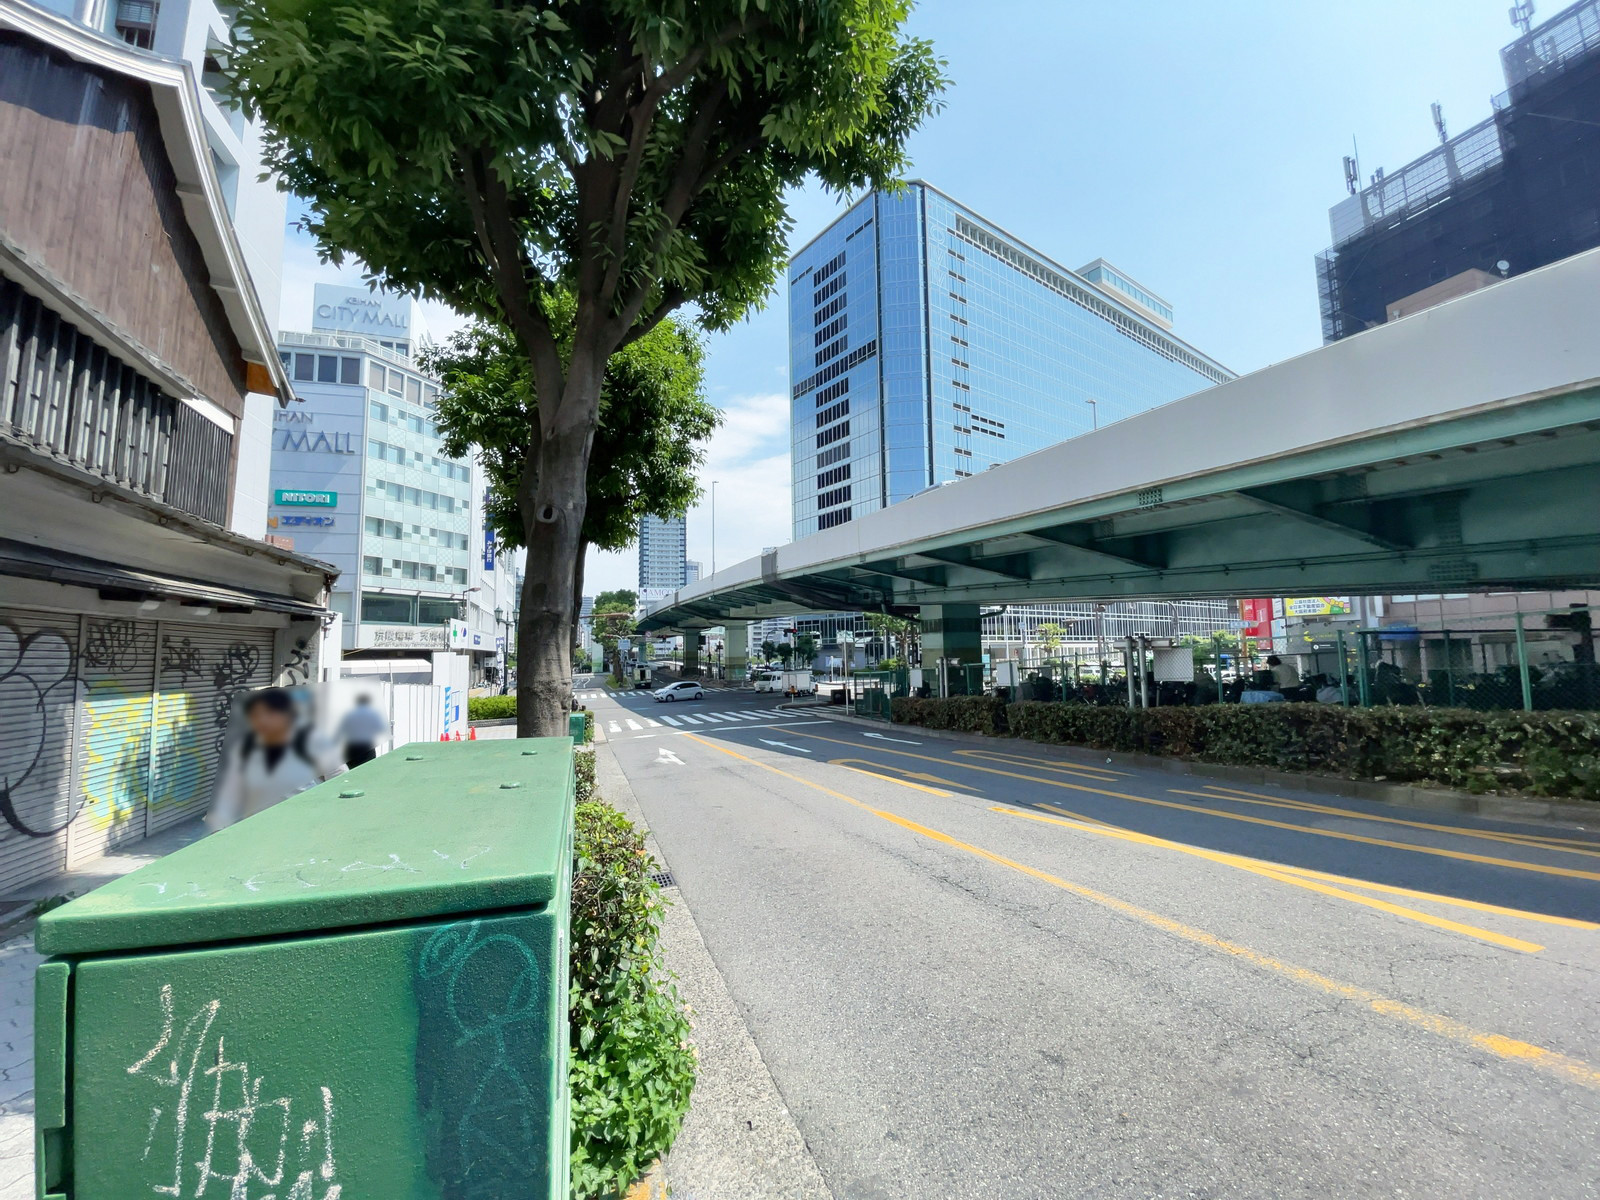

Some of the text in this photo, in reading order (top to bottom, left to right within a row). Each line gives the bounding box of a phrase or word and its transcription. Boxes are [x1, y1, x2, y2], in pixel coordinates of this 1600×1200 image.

[344, 297, 382, 308] KEIHAN
[317, 304, 407, 328] CITY MALL
[282, 429, 355, 454] MALL
[282, 492, 330, 504] NITORI
